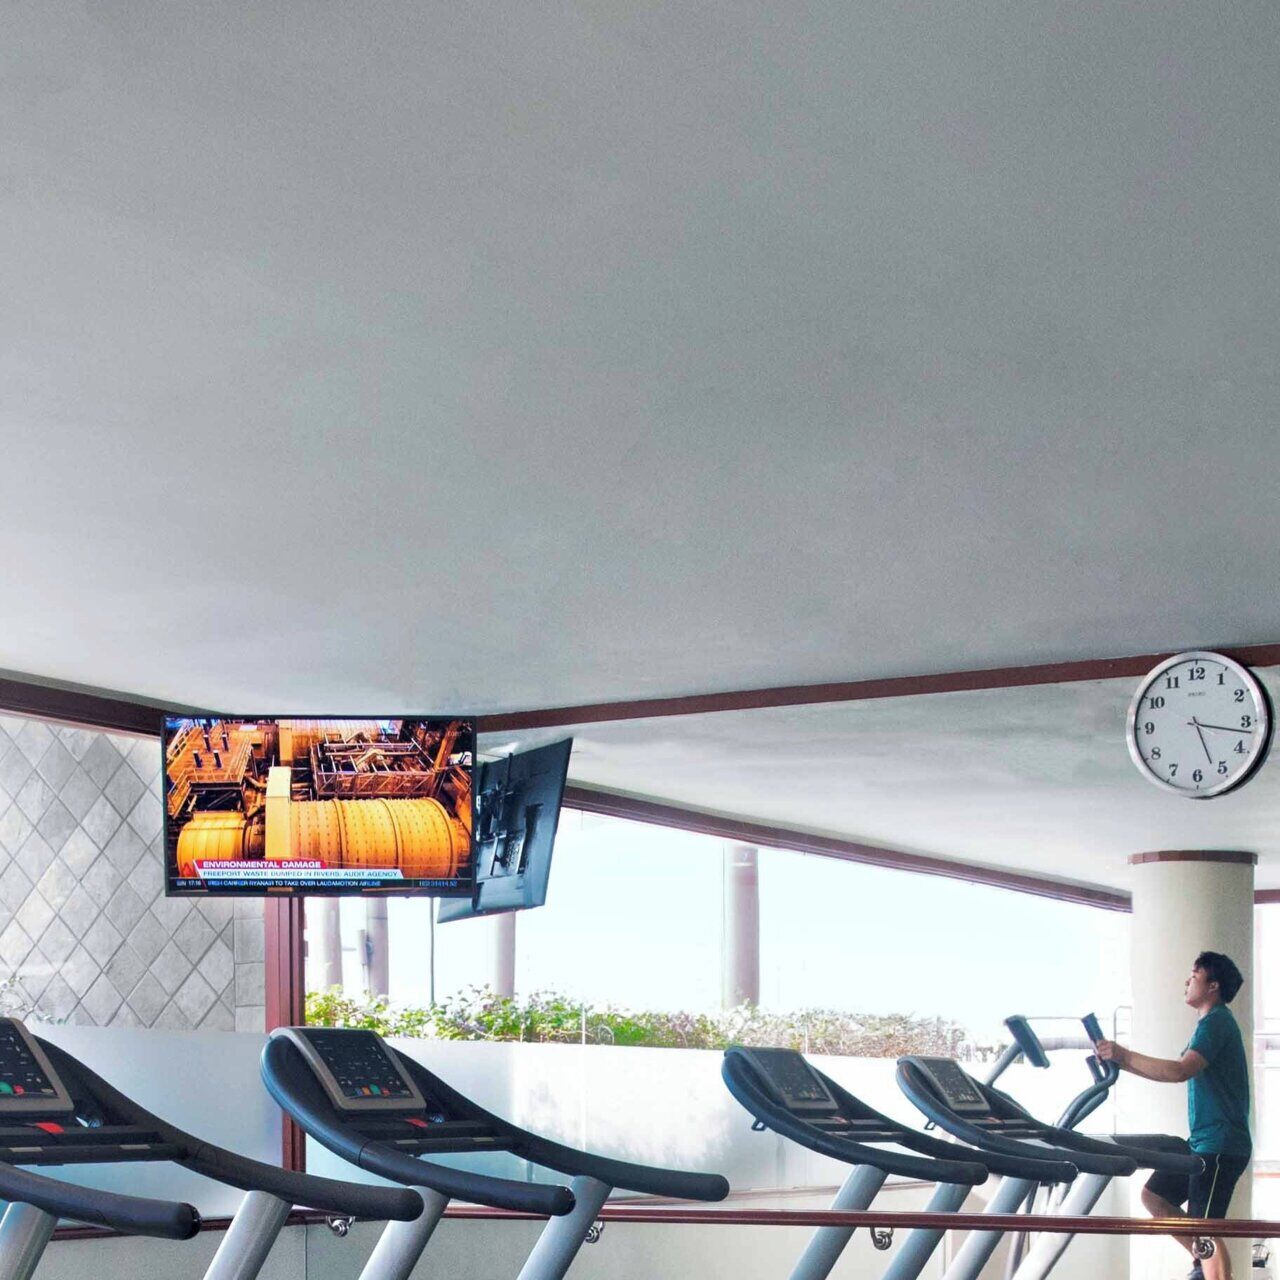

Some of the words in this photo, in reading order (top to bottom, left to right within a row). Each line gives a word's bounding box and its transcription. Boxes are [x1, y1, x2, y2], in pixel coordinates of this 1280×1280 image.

[1187, 667, 1205, 681] 12
[1218, 673, 1225, 685] 1
[1166, 676, 1180, 689] 11
[1149, 696, 1165, 709] 10
[1234, 689, 1244, 703] 2
[1241, 715, 1251, 728] 3
[1145, 722, 1154, 735] 9
[1151, 747, 1161, 760] 8
[1234, 740, 1245, 754] 4
[1169, 764, 1178, 776] 7
[1217, 761, 1227, 774] 5
[1193, 769, 1203, 782] 6
[203, 861, 279, 869] ENVIRONMENTAL
[282, 861, 321, 869] DAMAGE
